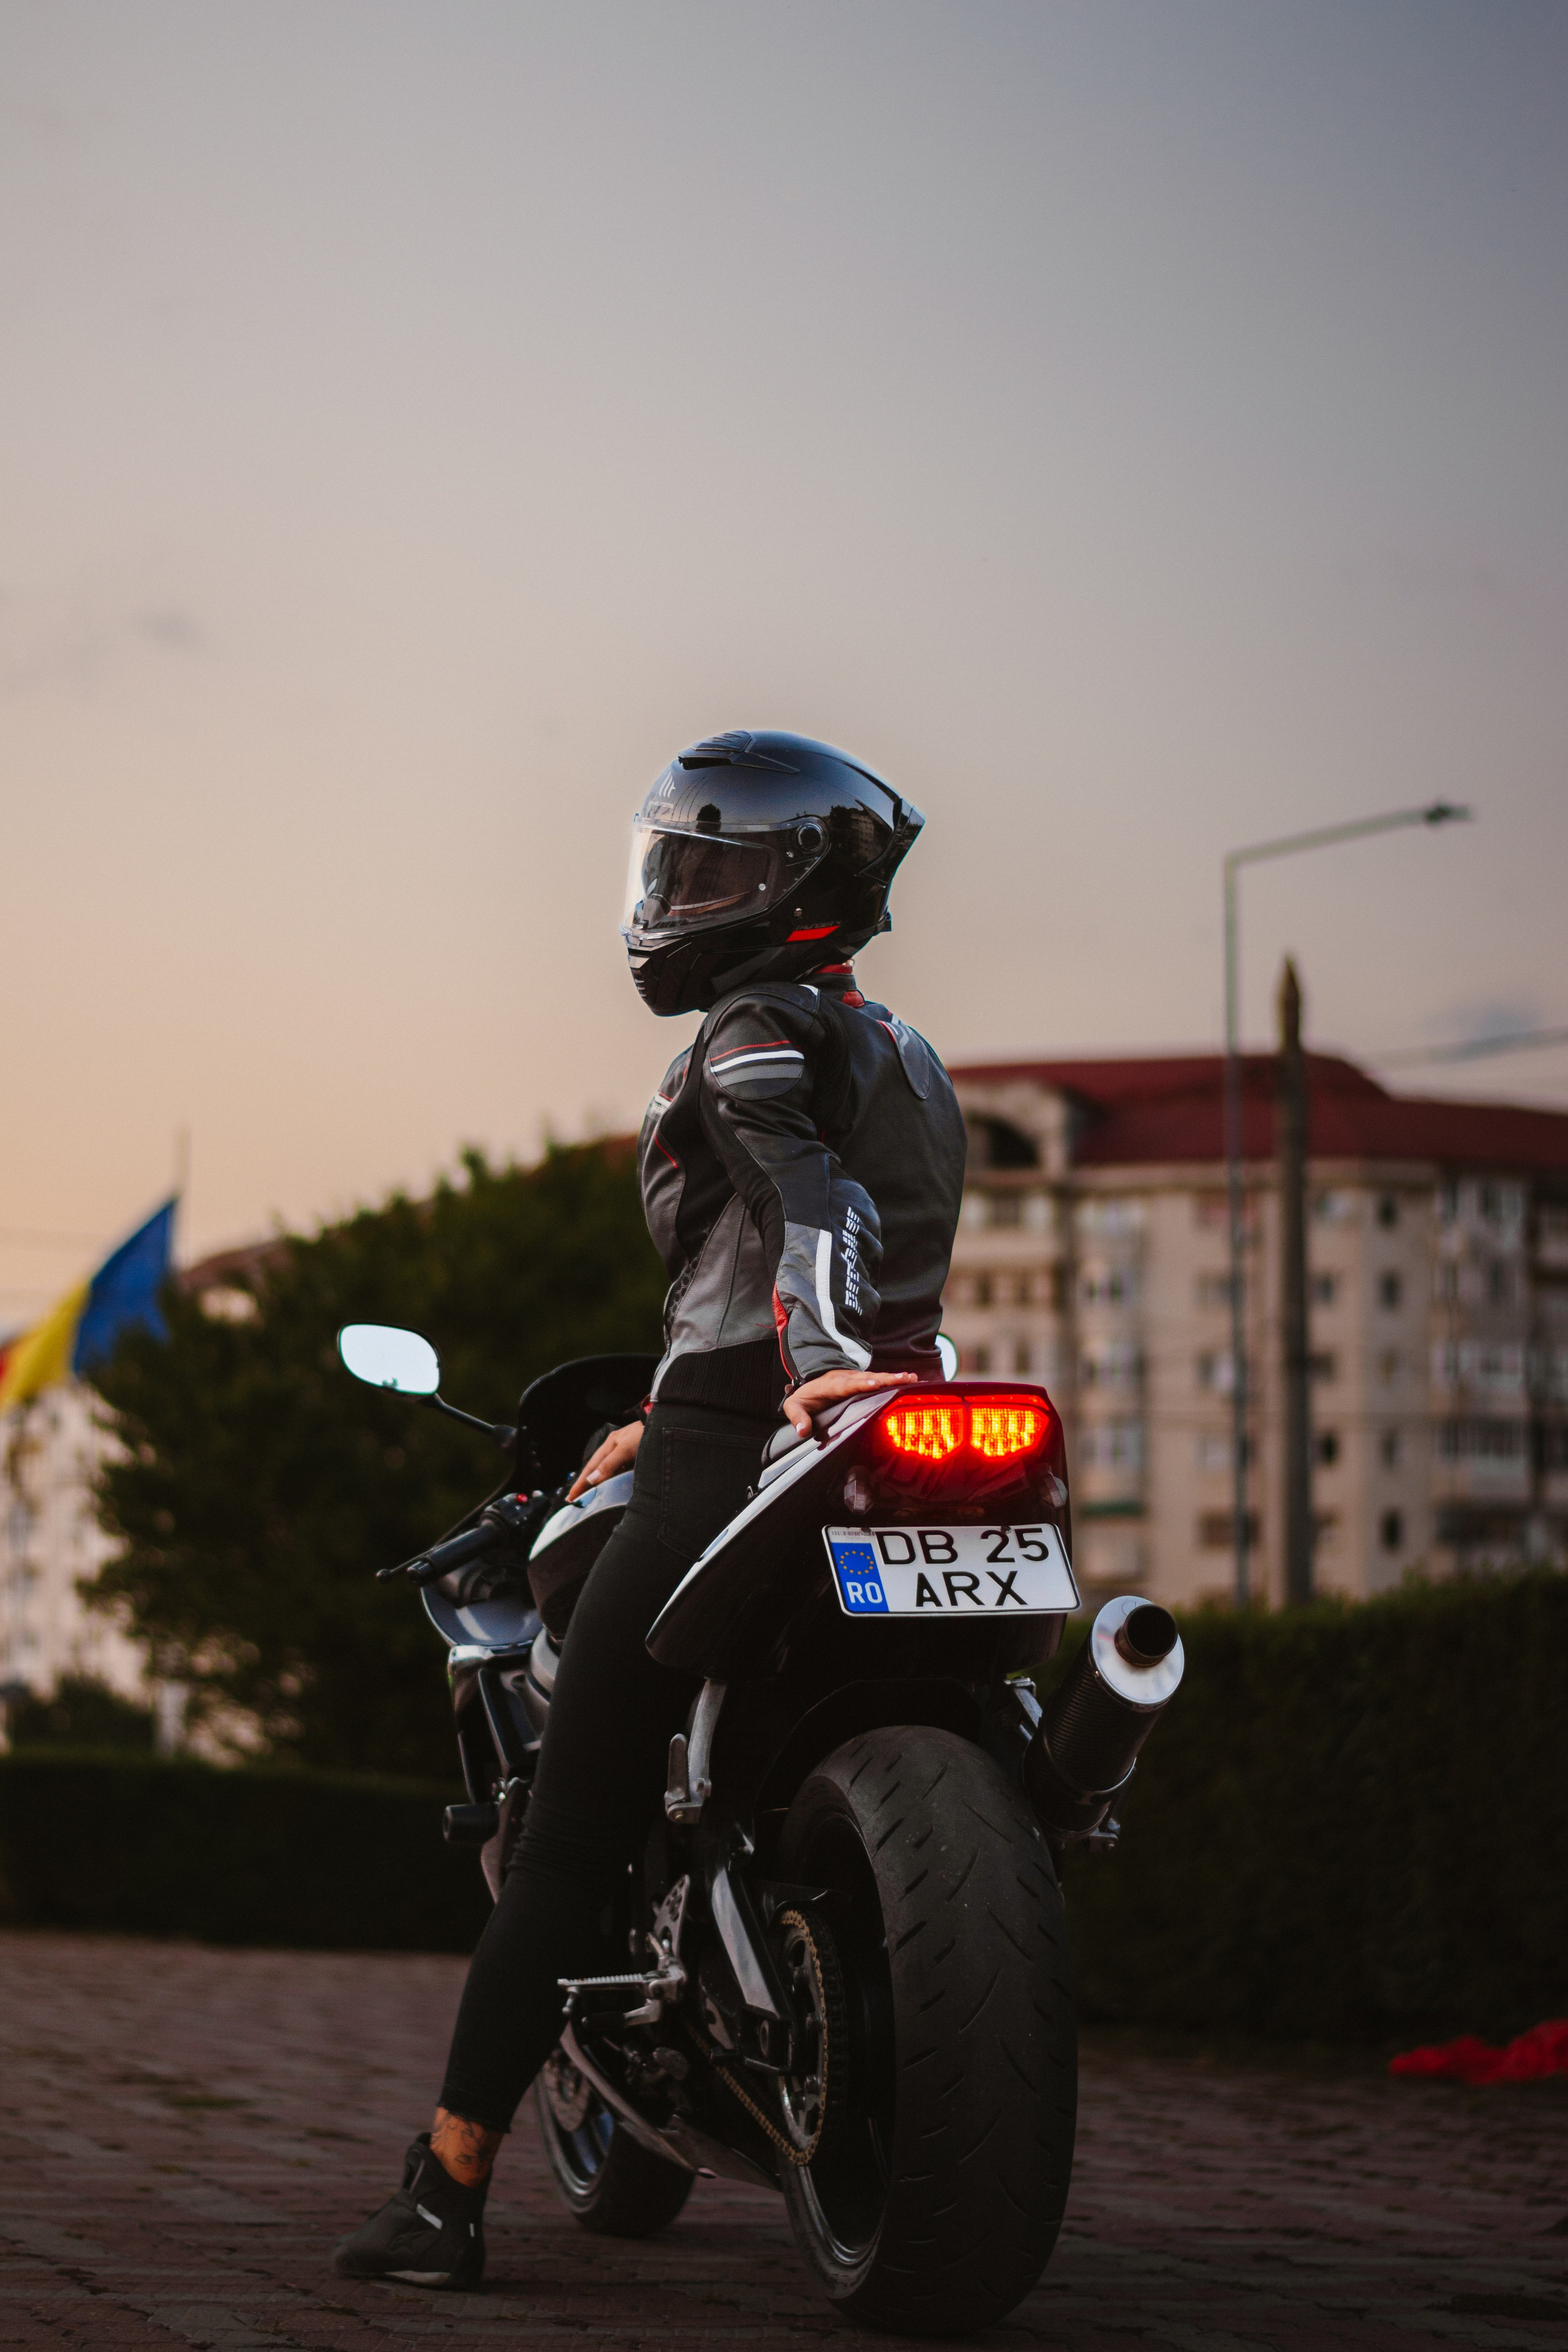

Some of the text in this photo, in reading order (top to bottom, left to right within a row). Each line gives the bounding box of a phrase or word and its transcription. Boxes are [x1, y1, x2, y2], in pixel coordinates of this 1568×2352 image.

[875, 1528, 1049, 1565] DB 25
[846, 1581, 882, 1604] RO
[916, 1570, 1028, 1607] ARX
